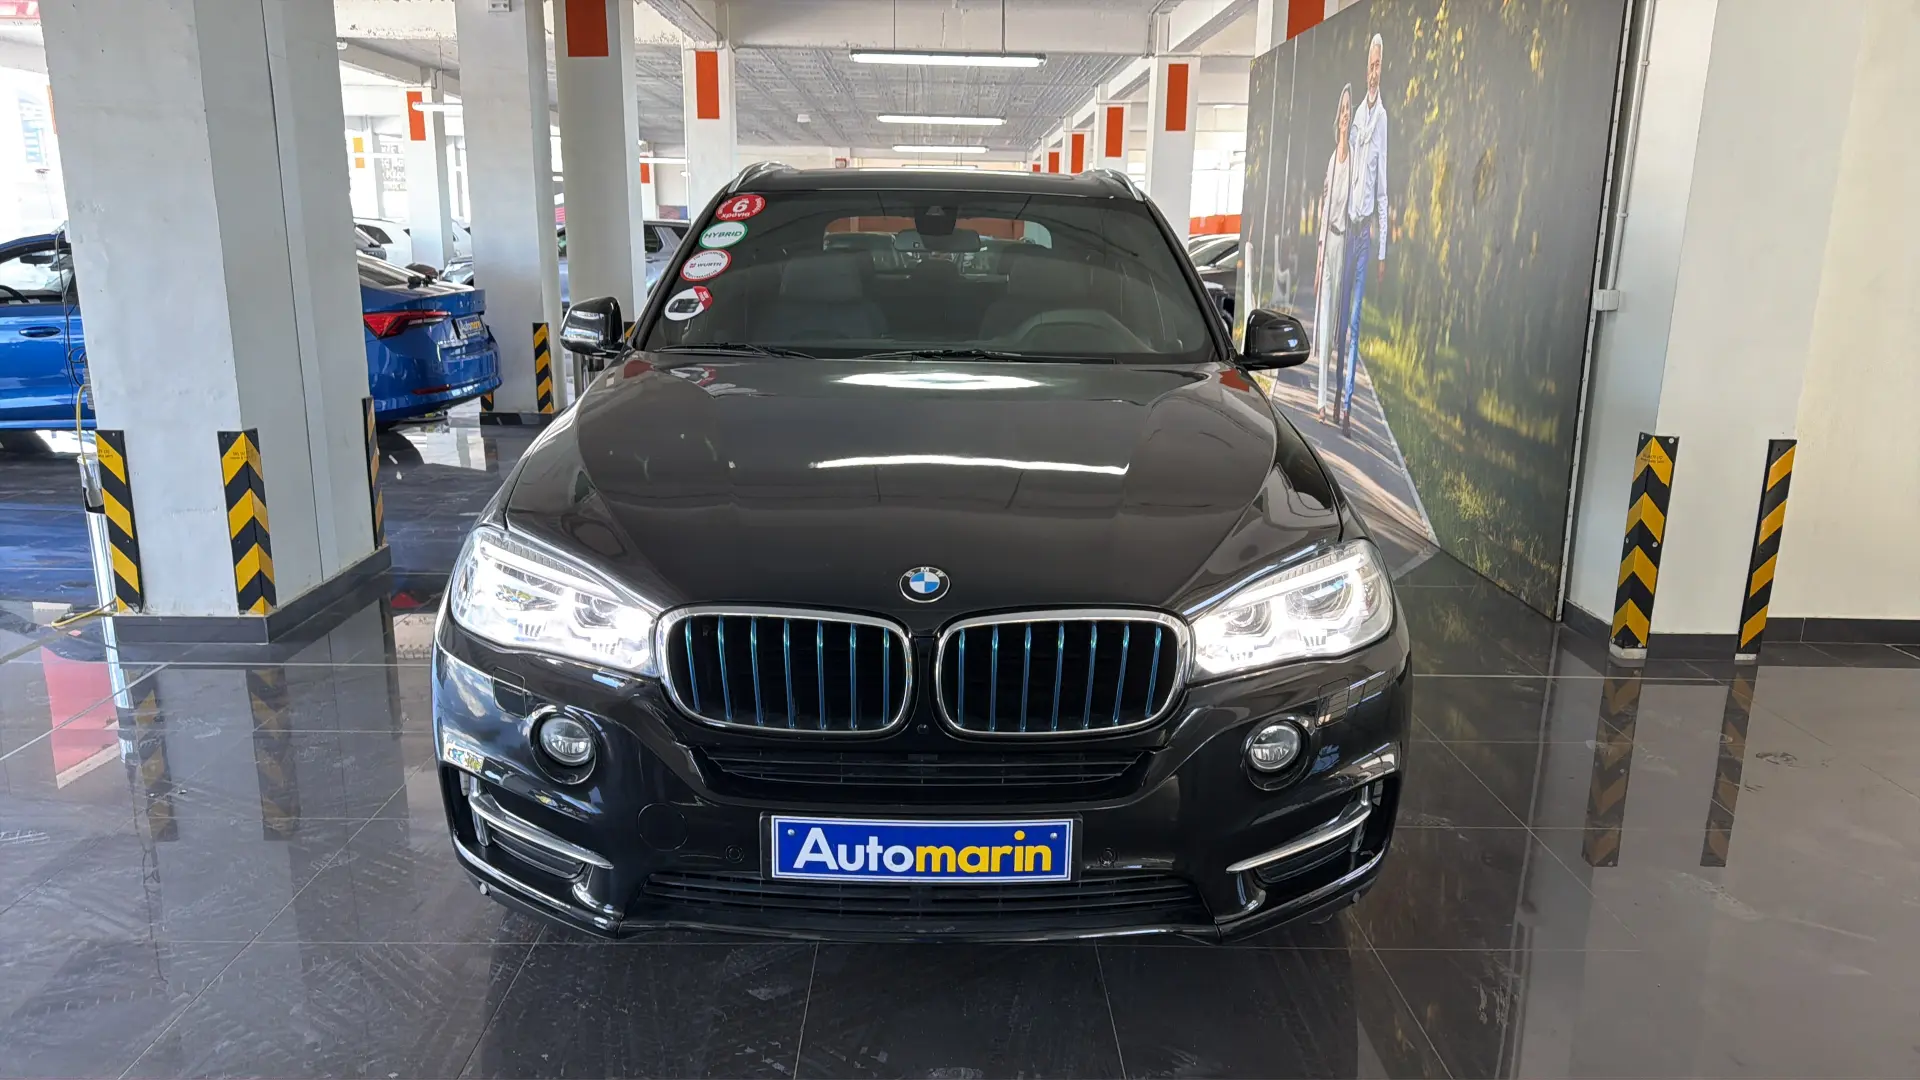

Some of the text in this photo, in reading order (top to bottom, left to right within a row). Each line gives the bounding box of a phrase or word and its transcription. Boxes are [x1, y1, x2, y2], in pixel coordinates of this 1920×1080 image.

[733, 200, 749, 213] 6
[905, 567, 946, 578] BMW
[793, 827, 1052, 873] Automarin
